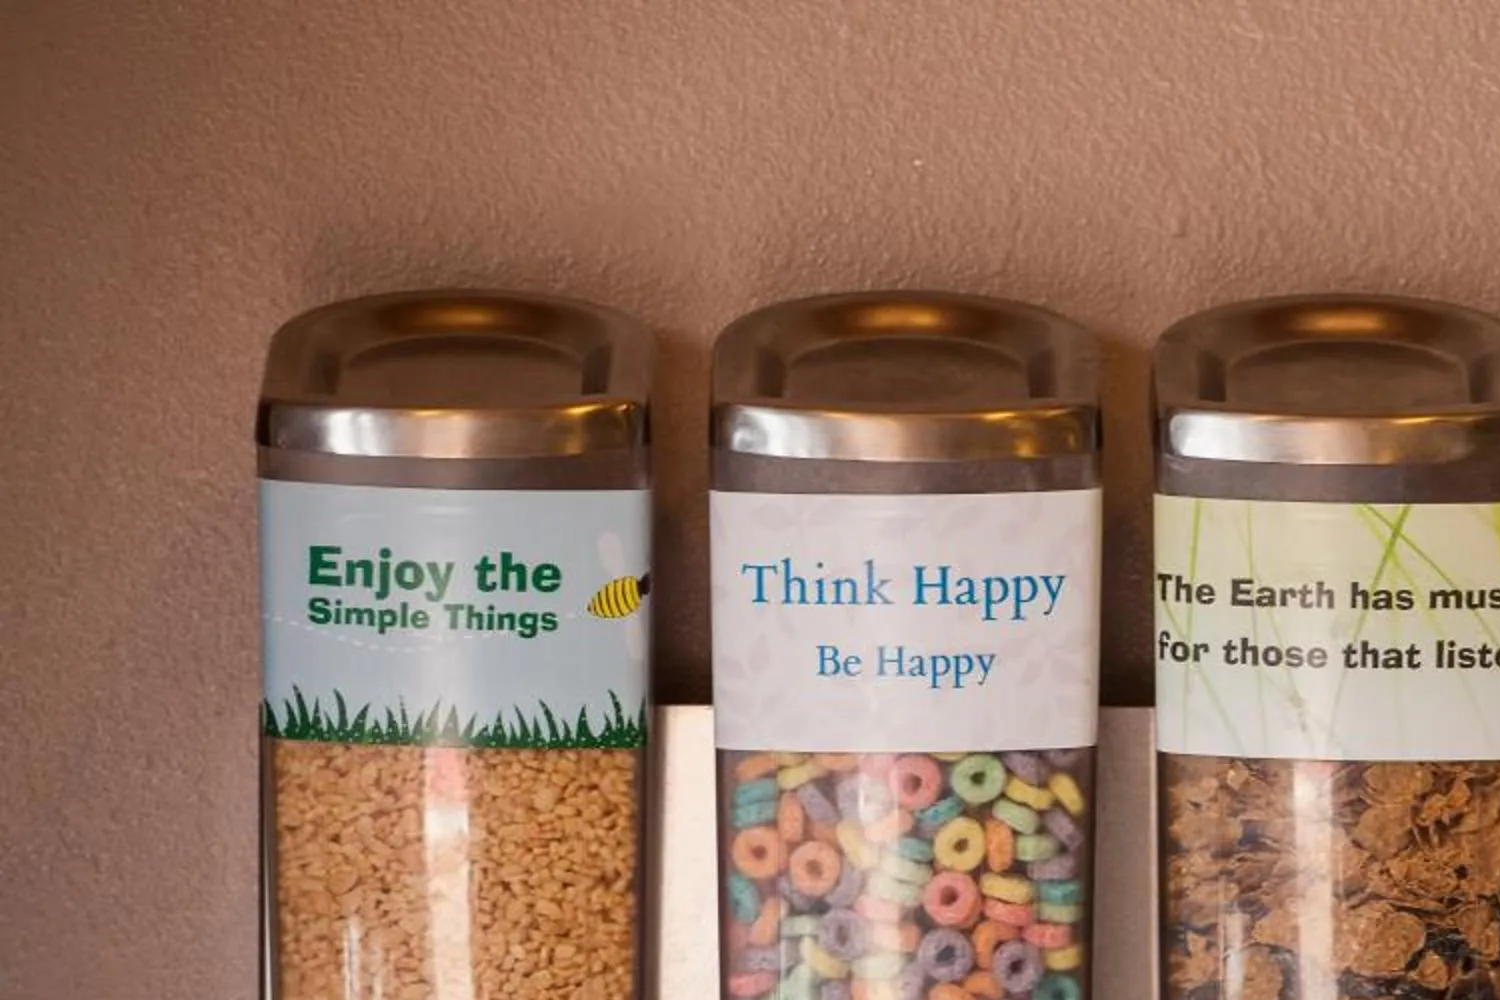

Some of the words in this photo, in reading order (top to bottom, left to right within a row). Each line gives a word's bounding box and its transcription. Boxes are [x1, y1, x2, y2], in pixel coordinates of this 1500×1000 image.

[309, 545, 455, 602] Enjoy
[474, 552, 562, 594] the
[741, 557, 896, 606] Think
[912, 565, 1067, 621] Happy
[1157, 573, 1217, 606] The
[1230, 578, 1336, 610] Earth
[1349, 581, 1415, 611] has
[308, 597, 430, 635] Simple
[444, 603, 558, 639] Things
[816, 644, 863, 678] Be
[876, 645, 997, 689] Happy
[1157, 630, 1210, 662] for
[1222, 637, 1329, 669] those
[1342, 640, 1422, 669] that
